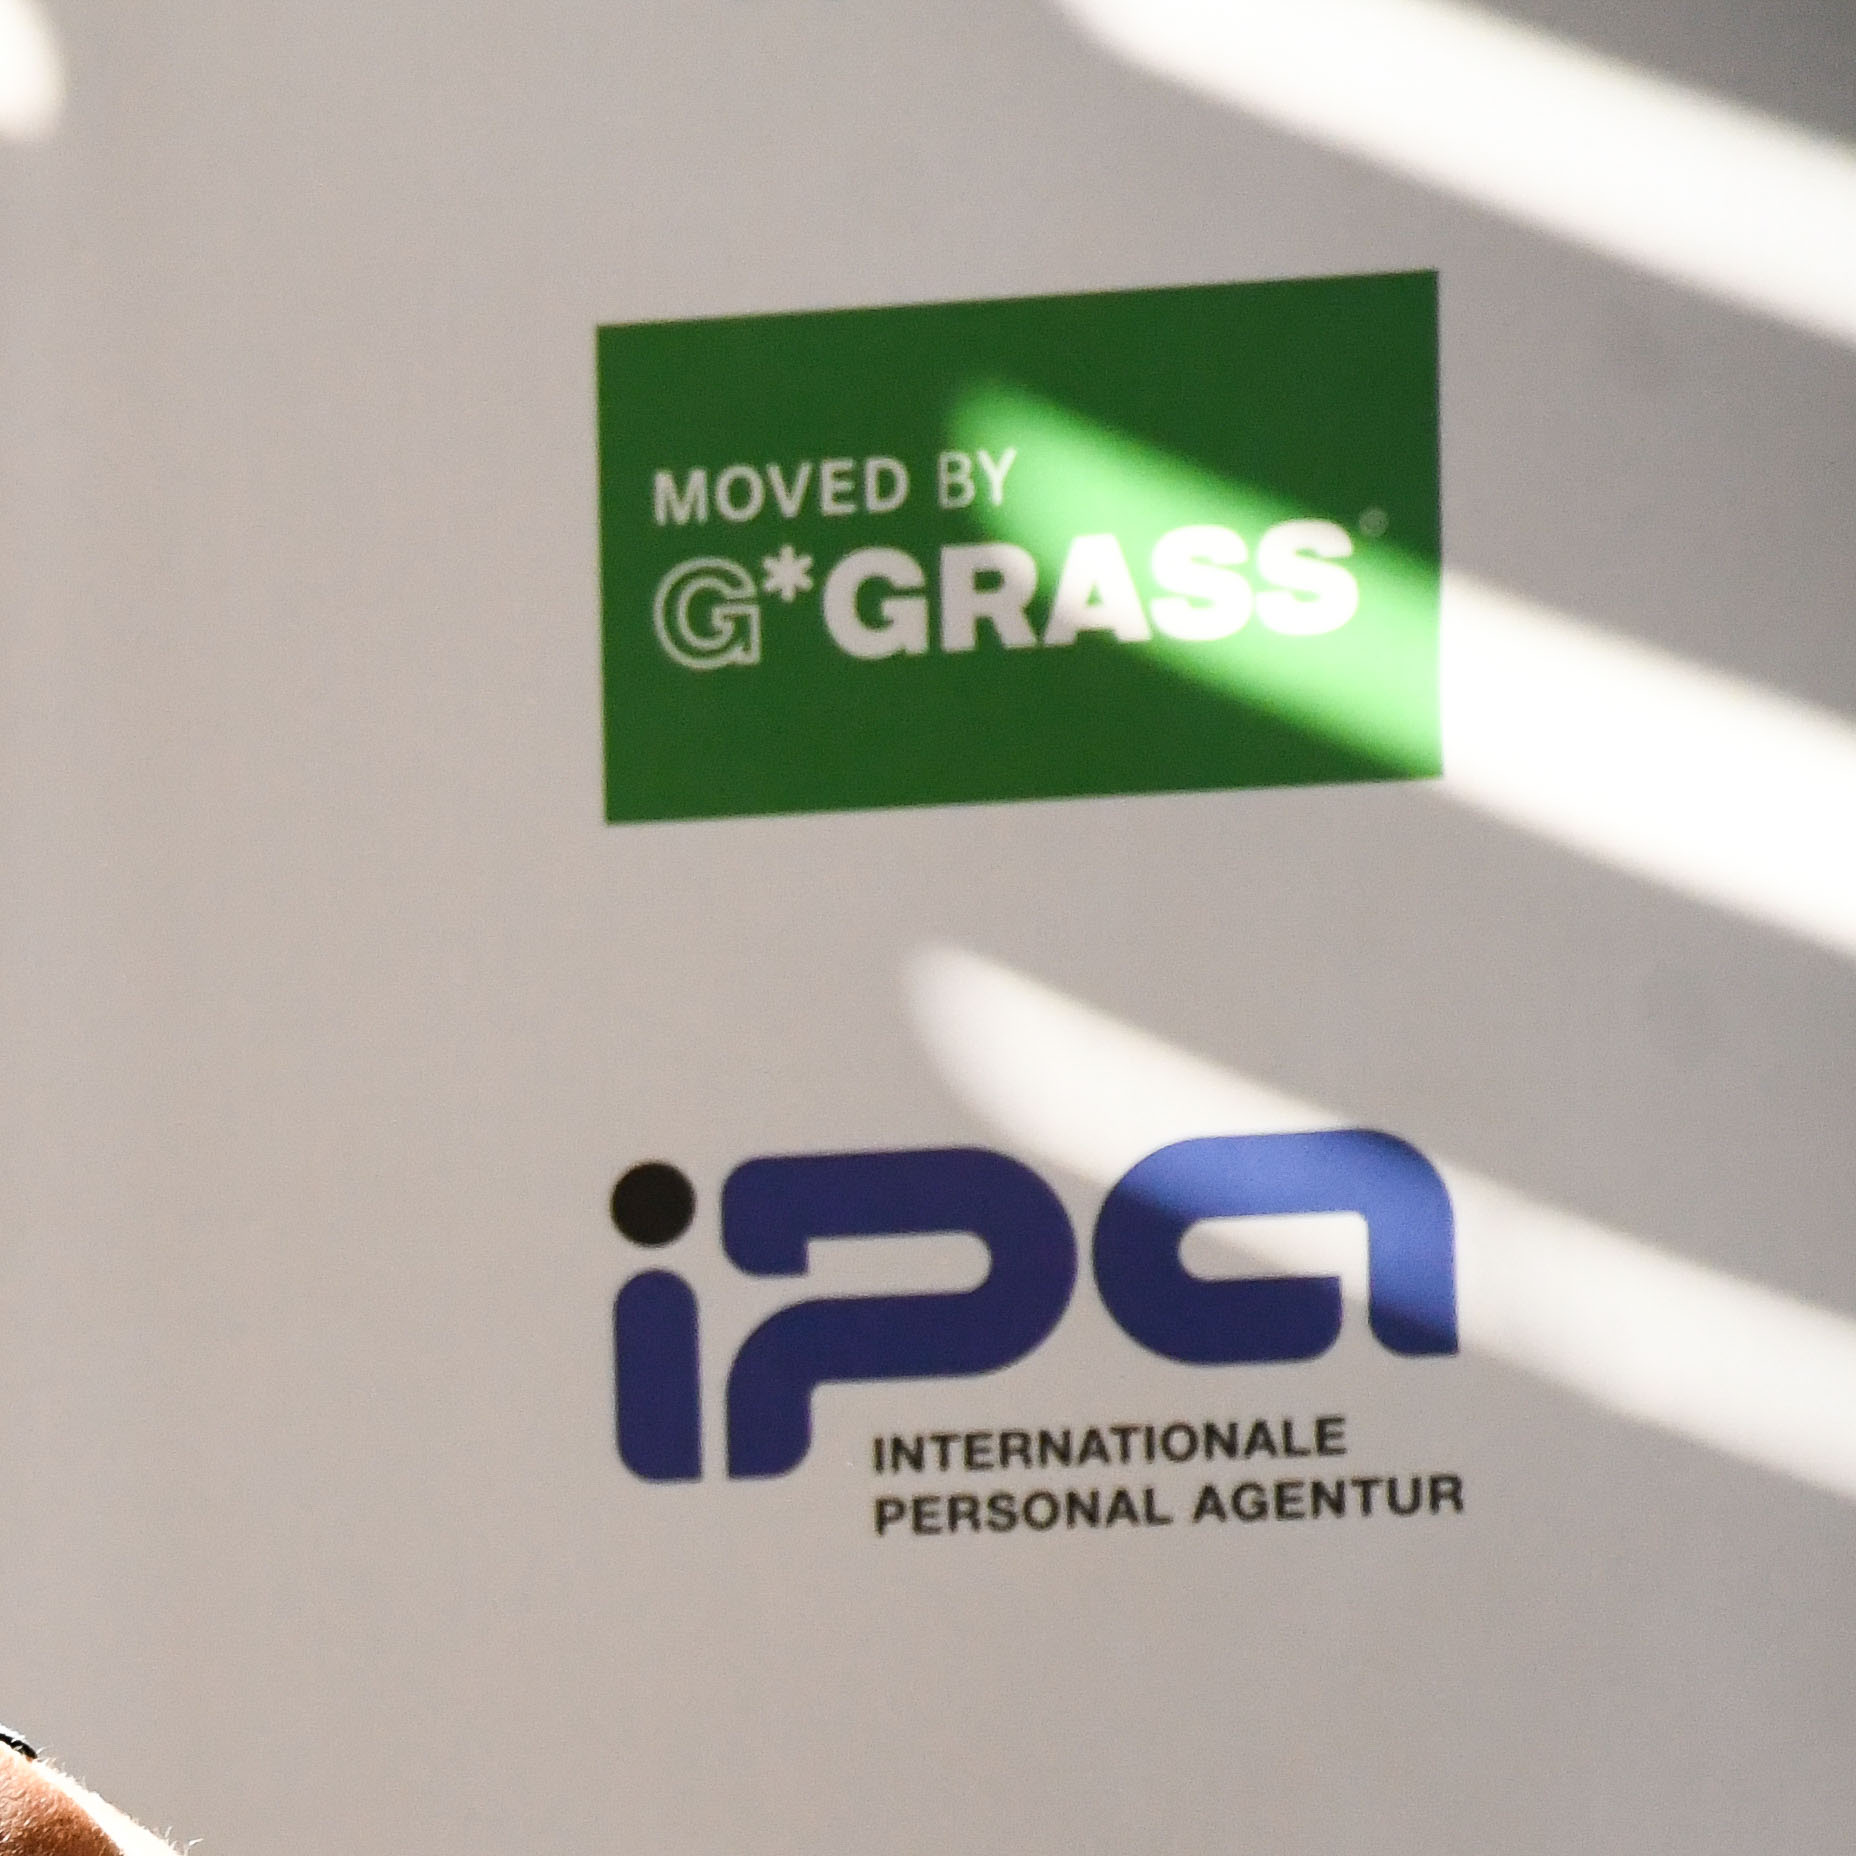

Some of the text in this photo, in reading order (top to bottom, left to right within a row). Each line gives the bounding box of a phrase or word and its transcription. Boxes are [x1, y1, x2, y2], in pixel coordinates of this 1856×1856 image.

[652, 448, 1017, 526] MOVED BY
[873, 1416, 1348, 1474] INTERNATIONALE
[874, 1474, 1465, 1536] PERSONAL AGENTUR
